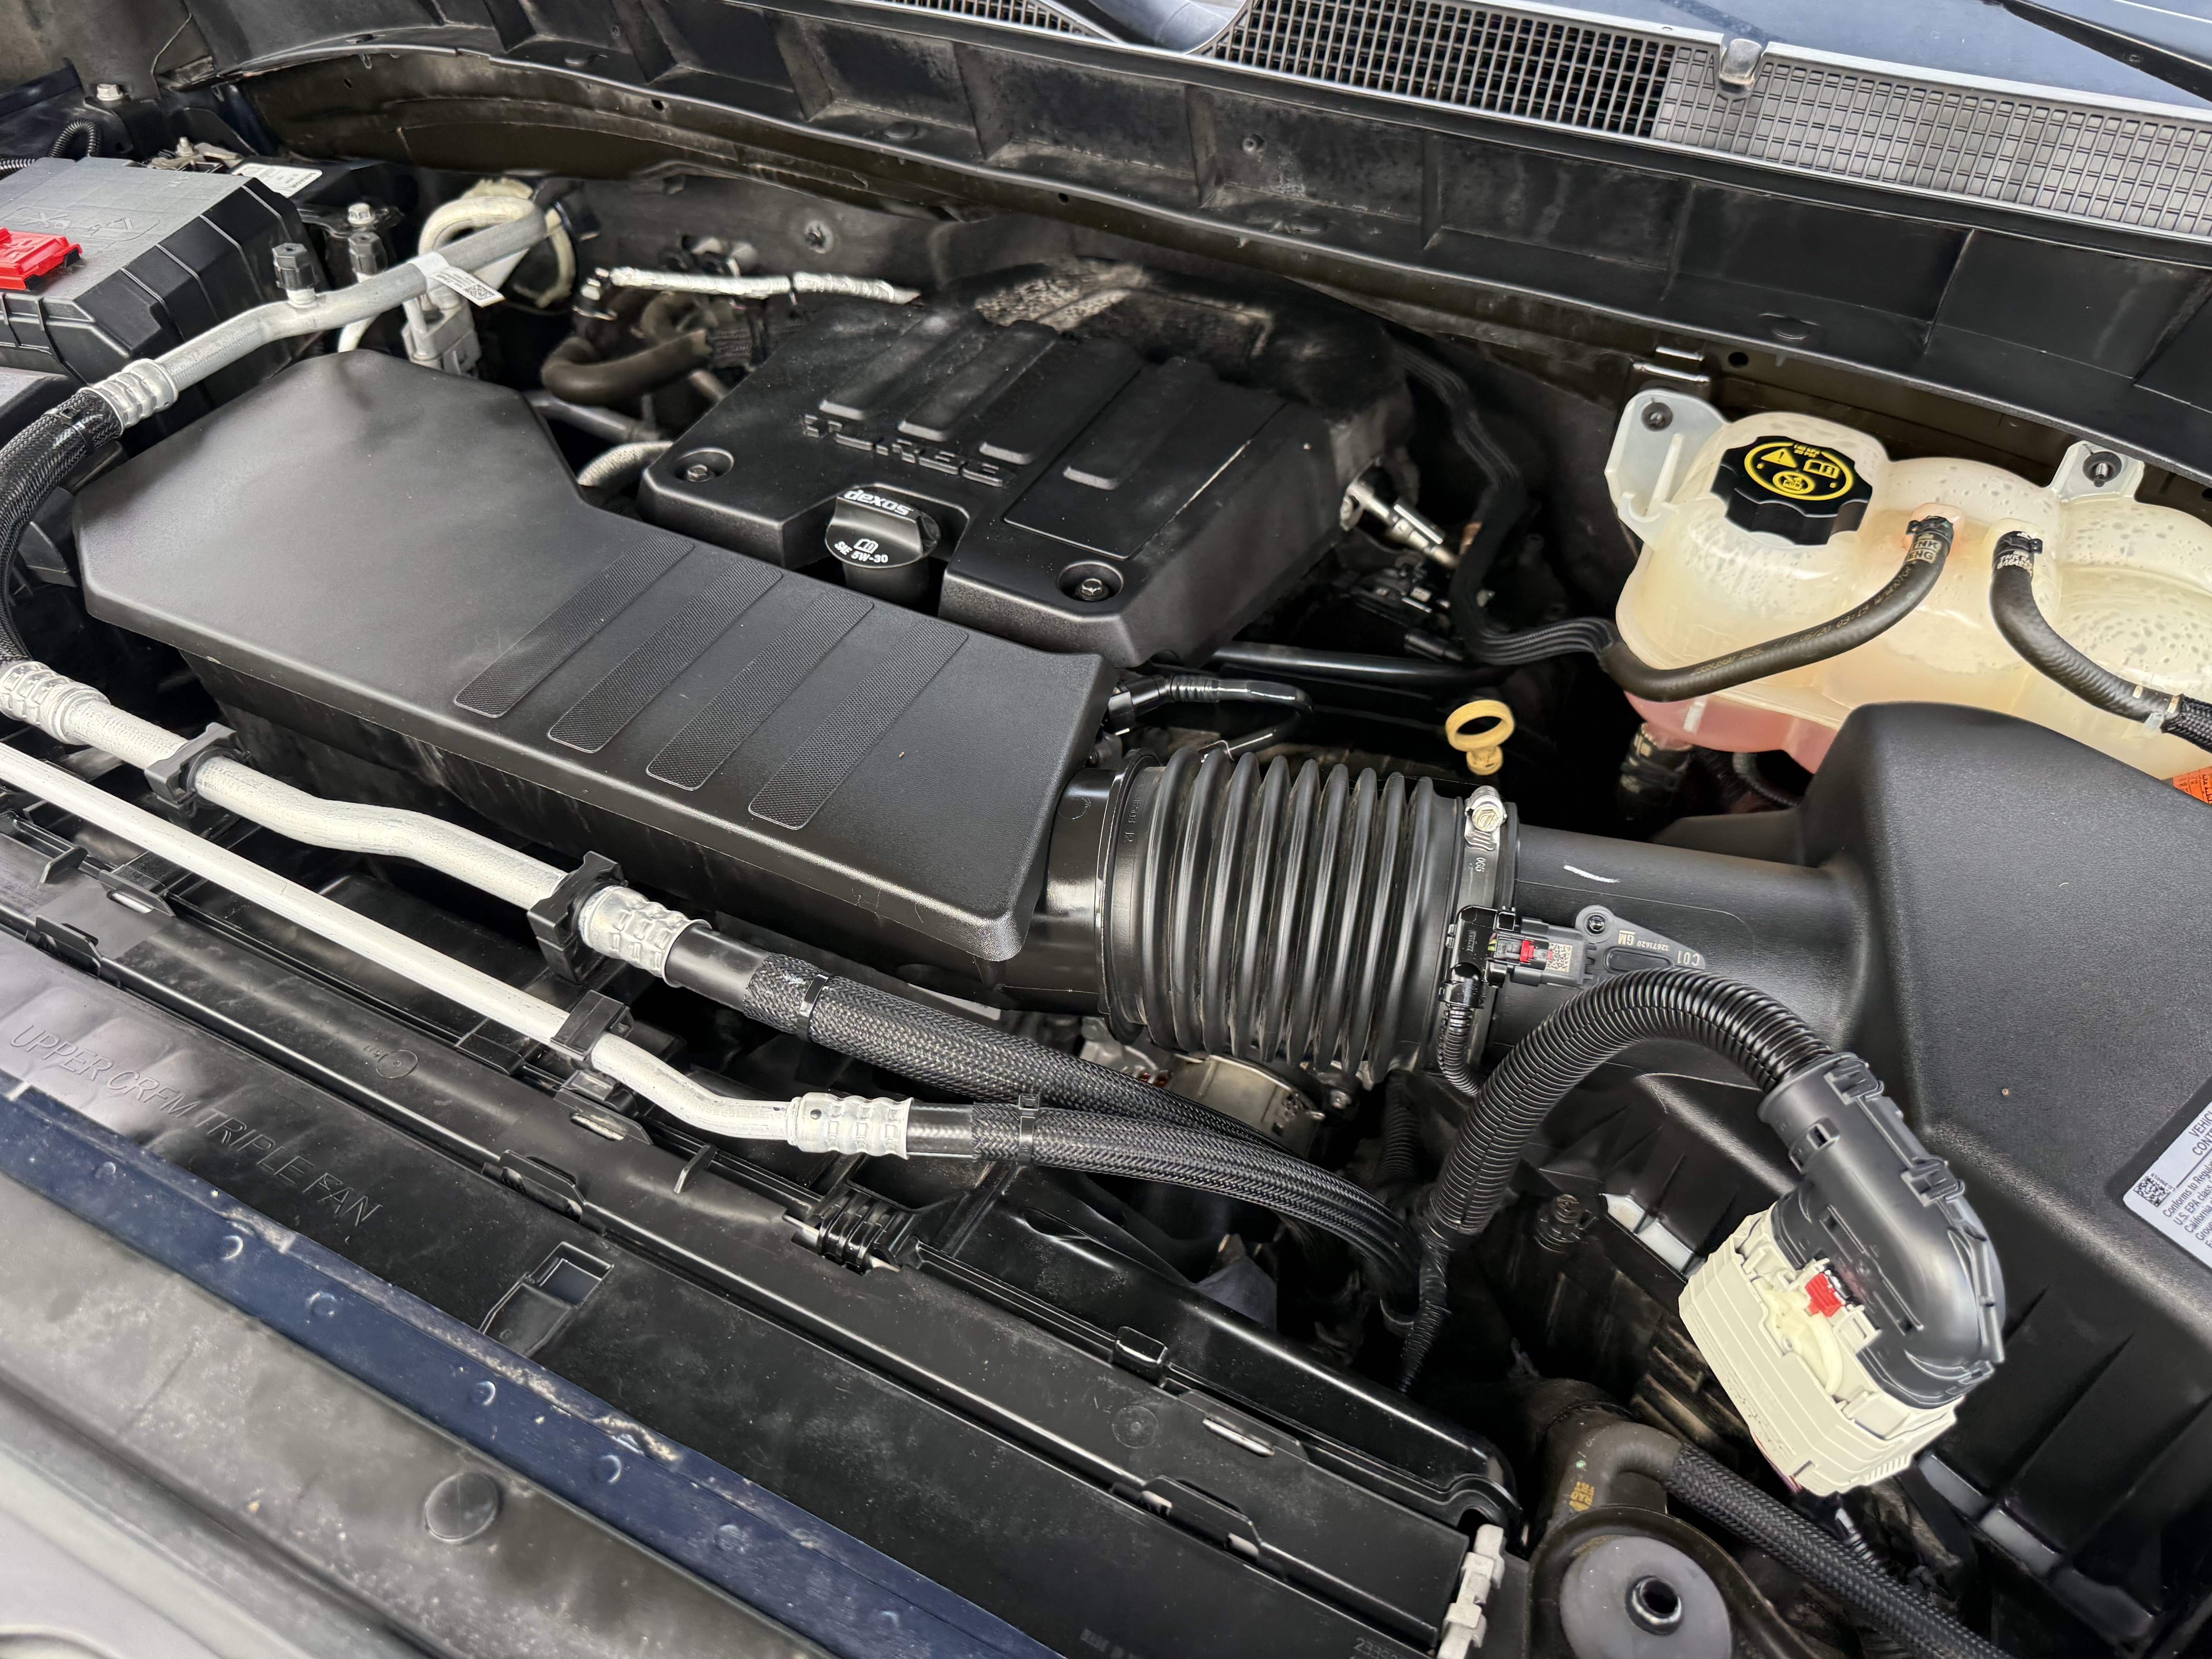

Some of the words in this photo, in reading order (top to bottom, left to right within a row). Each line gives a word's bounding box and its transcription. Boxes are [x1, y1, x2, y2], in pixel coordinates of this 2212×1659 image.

[843, 489, 912, 516] dexos
[834, 541, 853, 555] SAE
[851, 551, 888, 563] 5W-30
[1908, 550, 1934, 560] ENG
[1618, 931, 1635, 946] GM
[10, 1025, 113, 1080] UPPER
[107, 1070, 201, 1118] CRFM
[195, 1108, 315, 1185] TRIPLE
[303, 1172, 383, 1228] FAN
[2192, 1127, 2212, 1156] CONT
[2162, 1188, 2192, 1217] Conforms
[2188, 1182, 2197, 1190] to
[2173, 1212, 2189, 1225] U.S.
[2184, 1199, 2201, 1213] EPA
[2184, 1205, 2212, 1233] California
